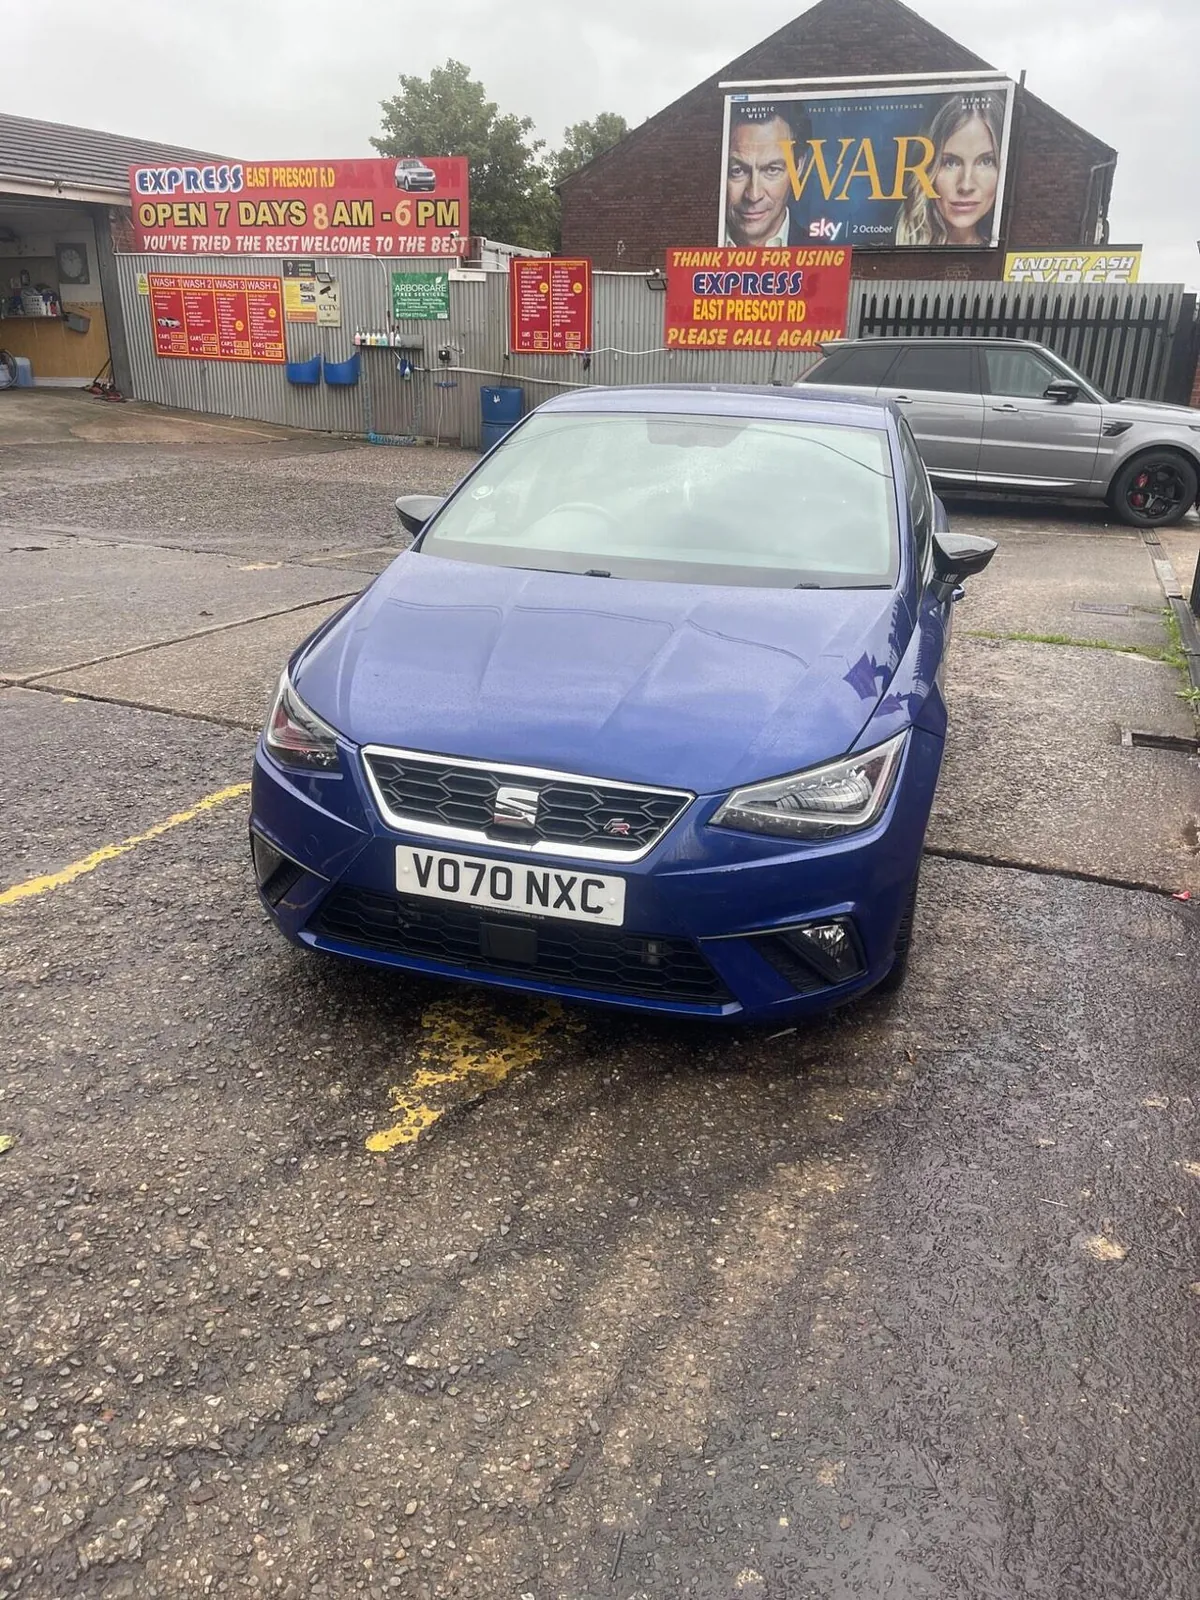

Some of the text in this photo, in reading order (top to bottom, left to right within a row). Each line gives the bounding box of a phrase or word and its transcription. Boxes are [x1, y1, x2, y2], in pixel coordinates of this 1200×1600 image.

[778, 136, 941, 201] WAR
[136, 165, 335, 194] EXPRESS EAST PRESCOT RD
[139, 202, 208, 227] OPEN
[214, 202, 230, 227] 7
[239, 200, 307, 227] DAYS
[417, 200, 460, 227] PM
[809, 217, 893, 240] sky 2 October
[143, 235, 468, 253] YOU'VE TRIED THE REST WELCOME TO THE BEST
[673, 250, 845, 267] THANK YOU FOR USING
[1013, 256, 1135, 270] KNOTTY ASH
[152, 278, 176, 287] WASH
[183, 279, 212, 288] WASH 2
[215, 280, 246, 289] WASH 3
[248, 281, 278, 290] WASH 4
[395, 284, 446, 292] ARBORCARE
[693, 271, 802, 296] EXPRESS
[693, 299, 806, 321] EAST PRESCOT RD
[668, 328, 727, 345] PLEASE
[733, 329, 772, 346] CALL
[412, 853, 605, 914] VO70 NXC
